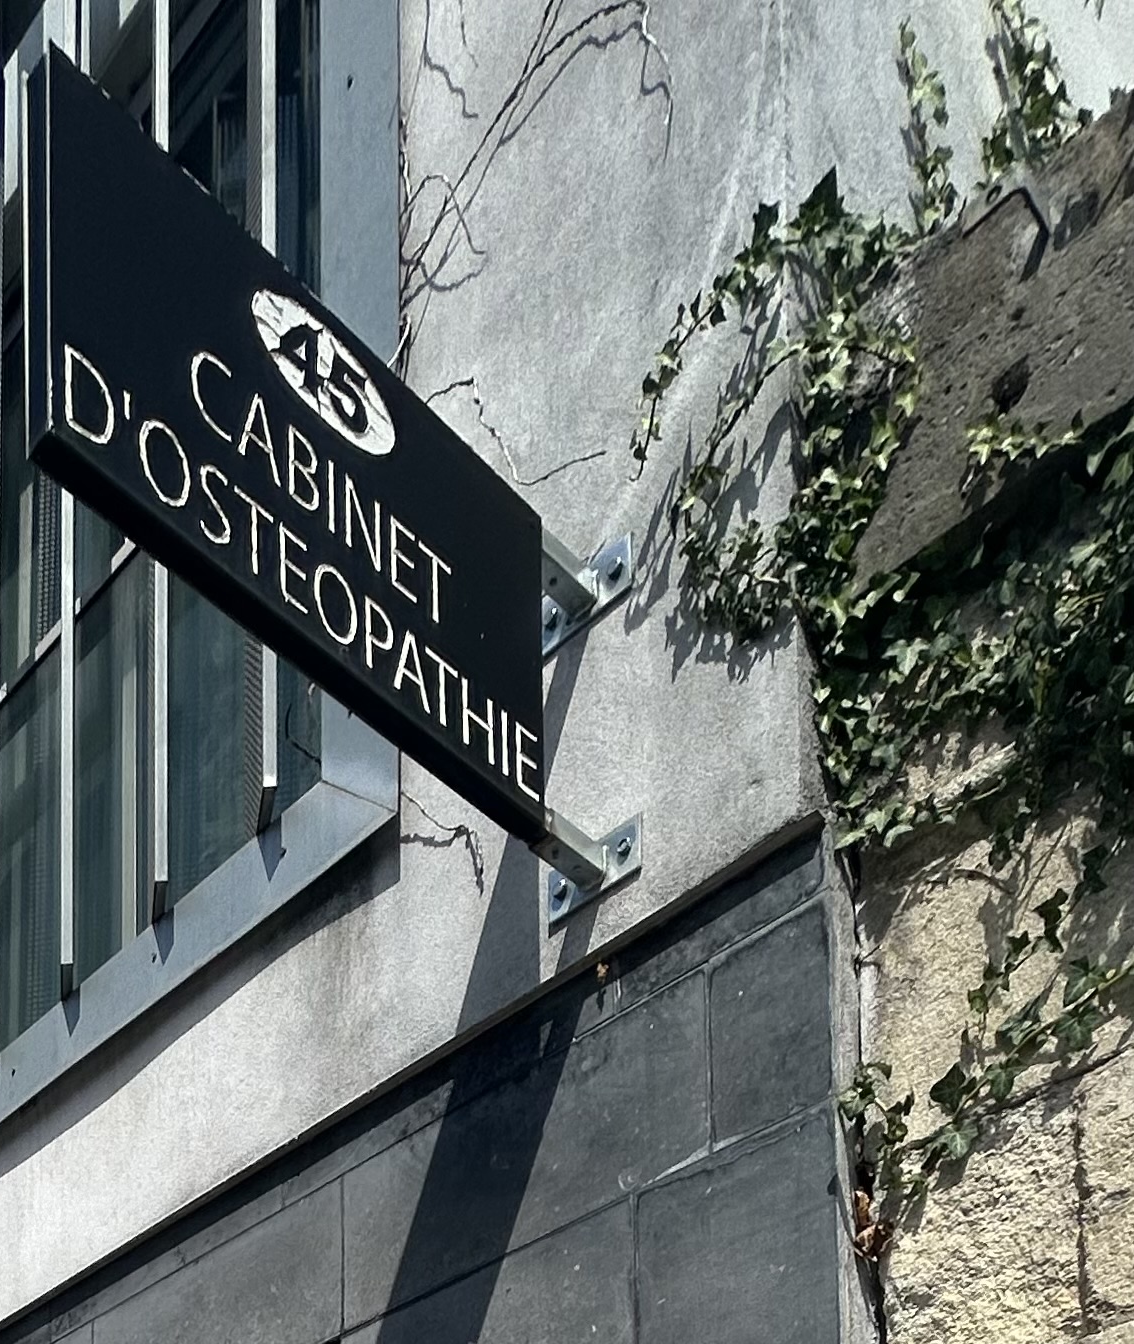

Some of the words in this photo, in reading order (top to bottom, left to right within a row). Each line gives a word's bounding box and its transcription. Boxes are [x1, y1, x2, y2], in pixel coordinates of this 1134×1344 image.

[191, 350, 451, 624] CABINET
[269, 322, 370, 437] 45
[64, 342, 540, 802] D'OSTEOPATHIE
